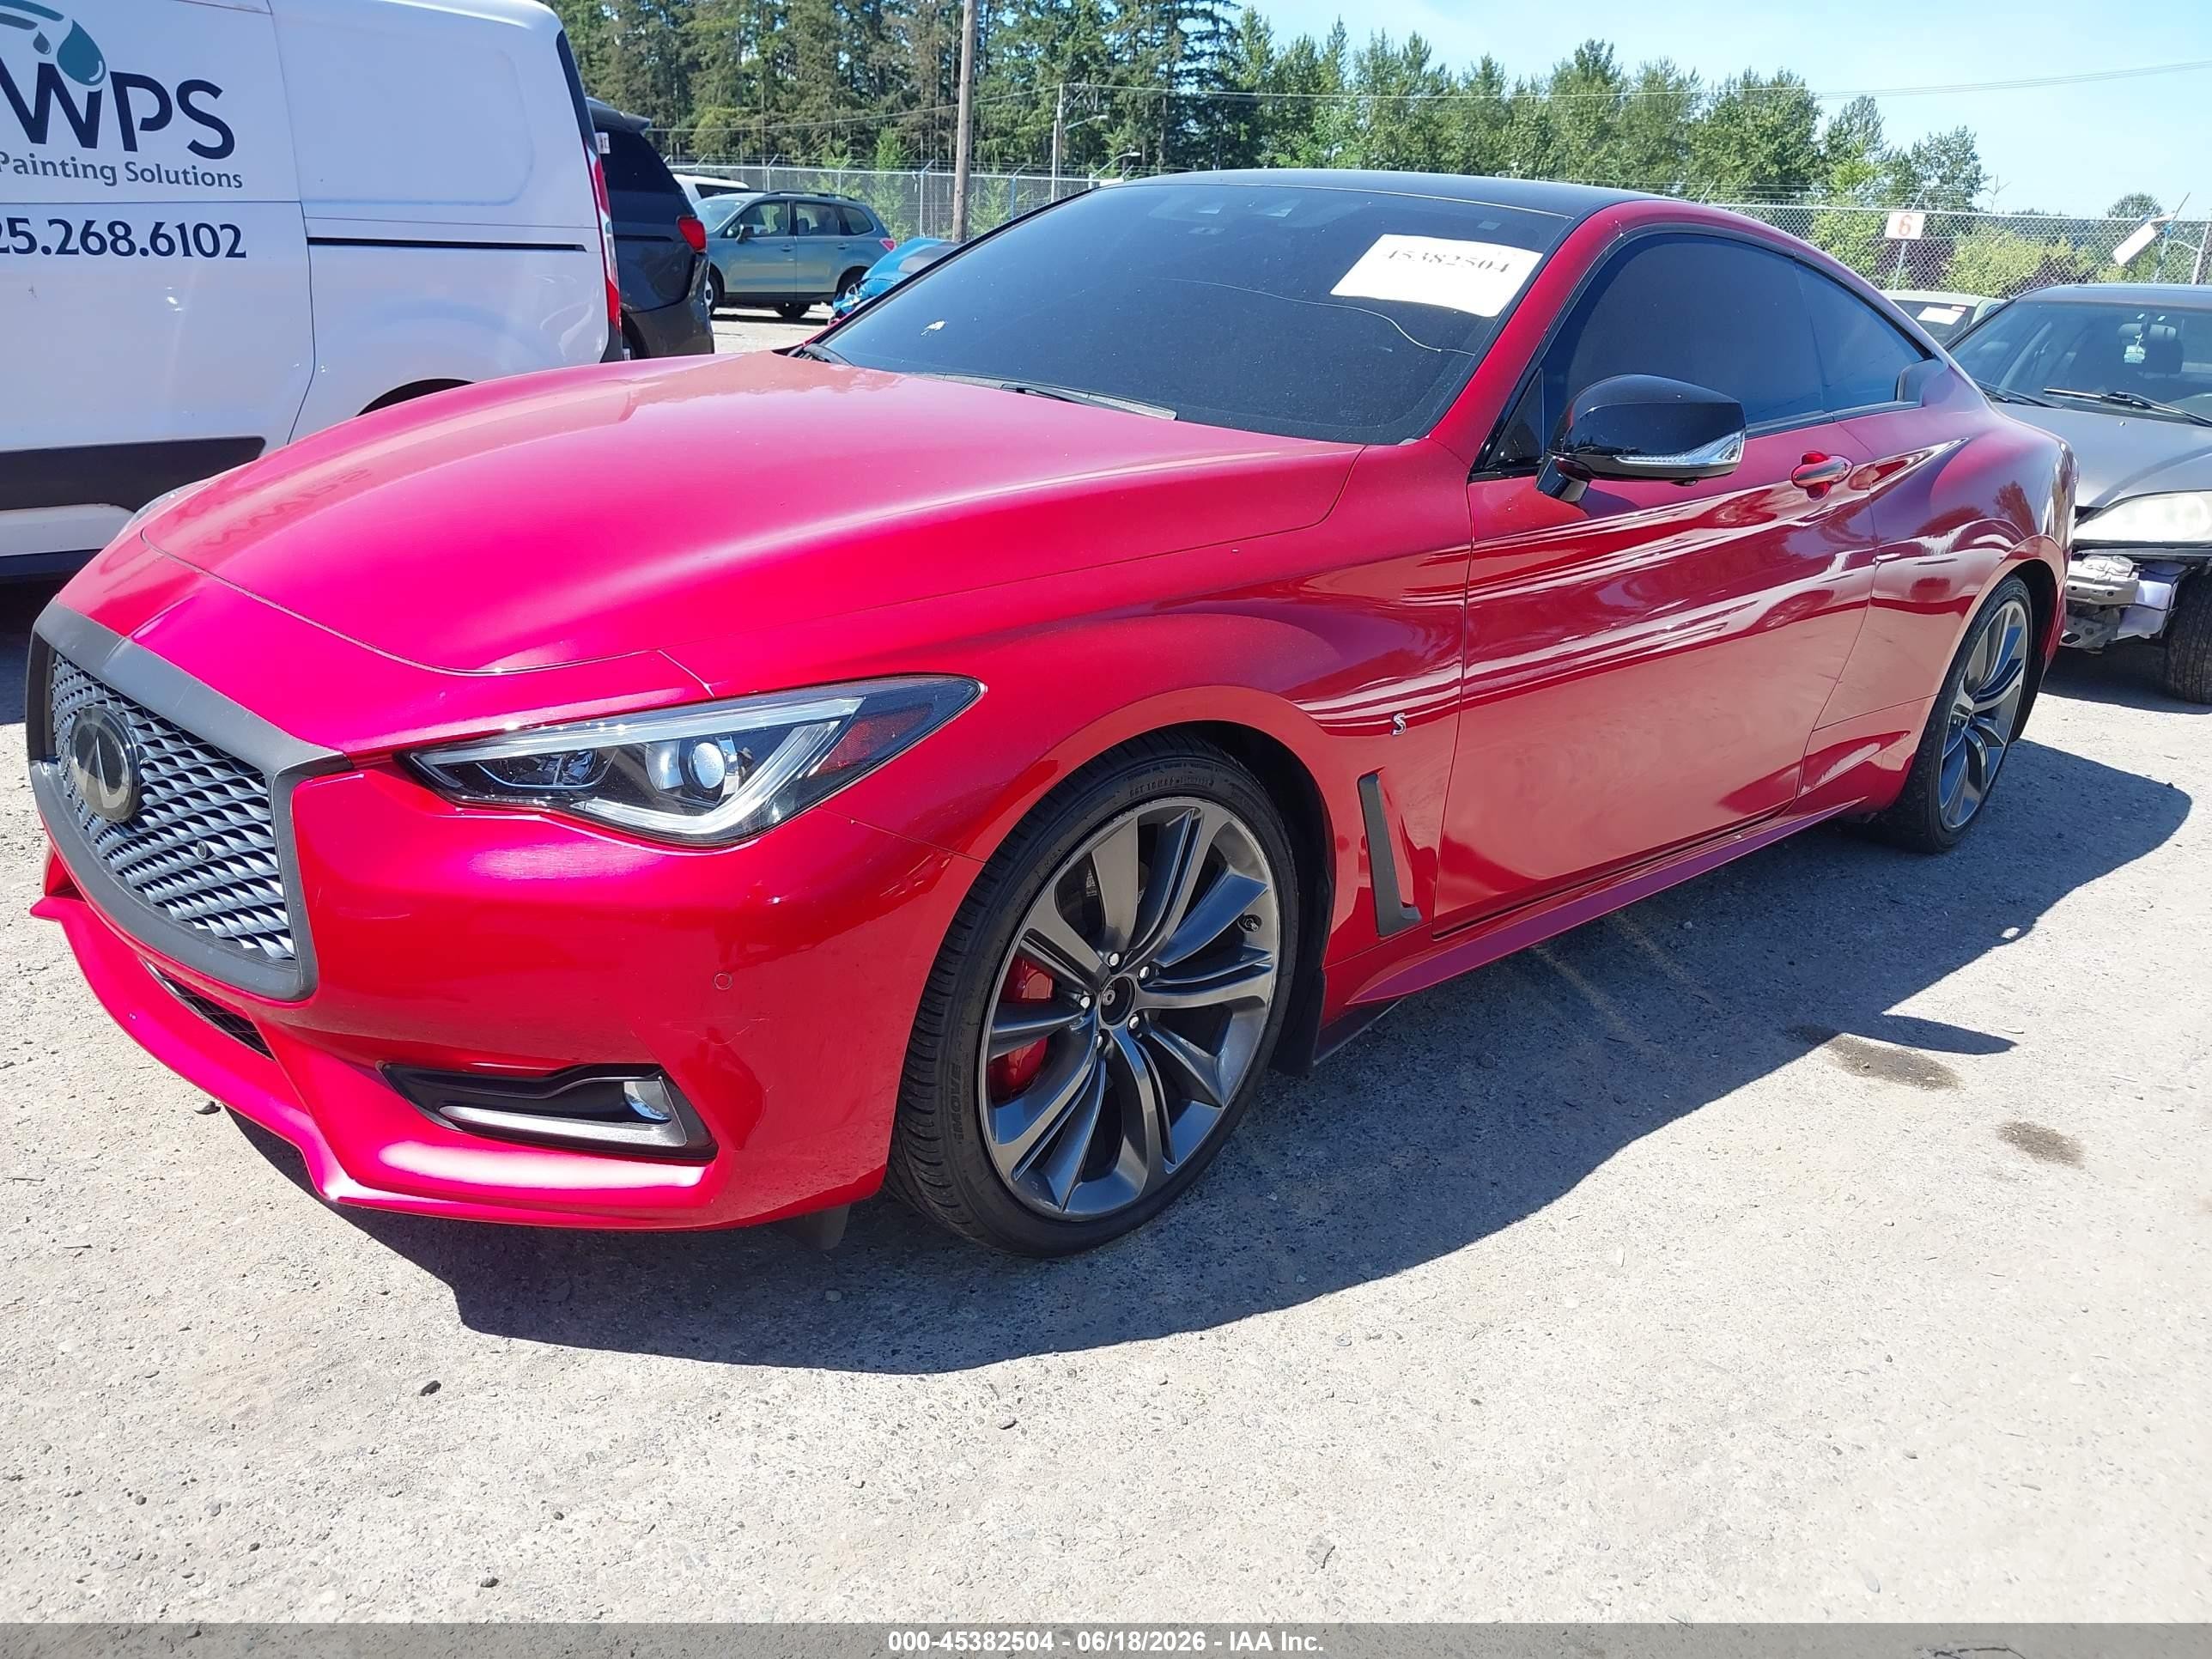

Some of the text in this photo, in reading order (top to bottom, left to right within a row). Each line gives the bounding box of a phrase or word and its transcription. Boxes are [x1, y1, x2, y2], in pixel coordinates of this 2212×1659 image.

[0, 57, 235, 160] WPS
[125, 161, 243, 189] Solutions
[1899, 214, 1913, 237] 6
